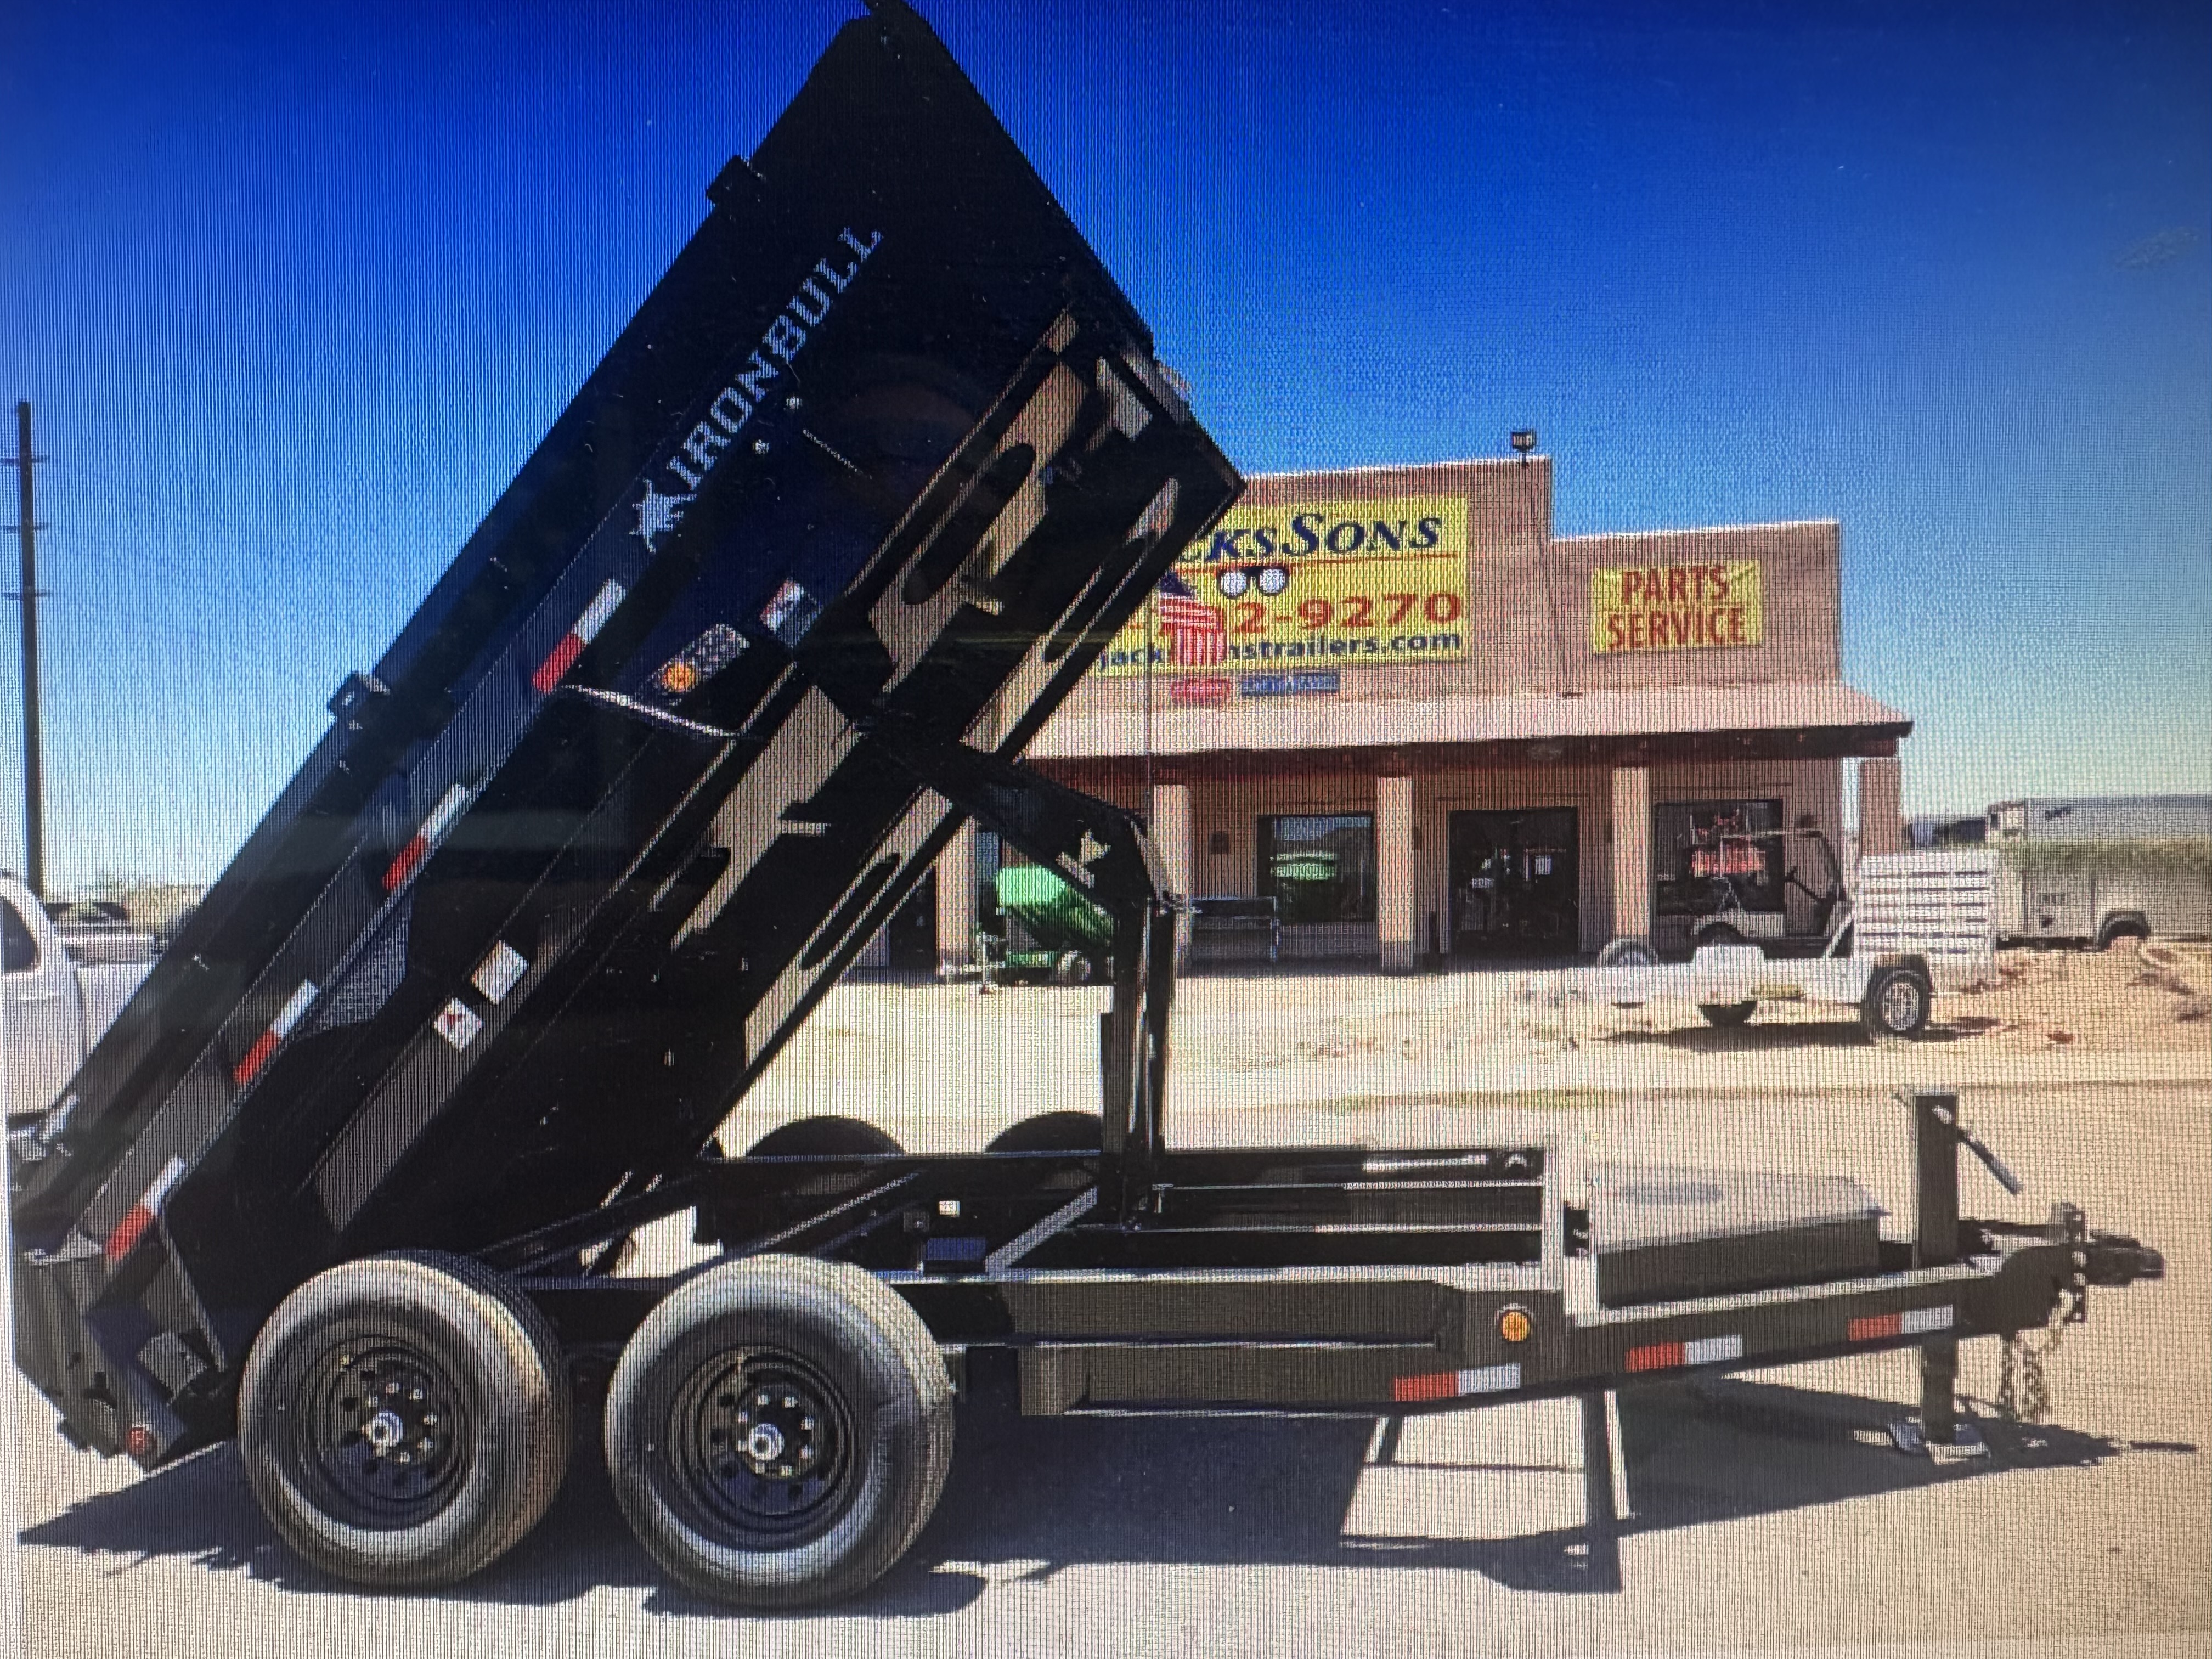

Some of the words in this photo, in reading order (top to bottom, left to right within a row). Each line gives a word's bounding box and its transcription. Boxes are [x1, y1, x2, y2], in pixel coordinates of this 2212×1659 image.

[666, 227, 884, 491] IRONBULL
[1621, 565, 1729, 605] PARTS
[1607, 607, 1746, 651] SERVICE
